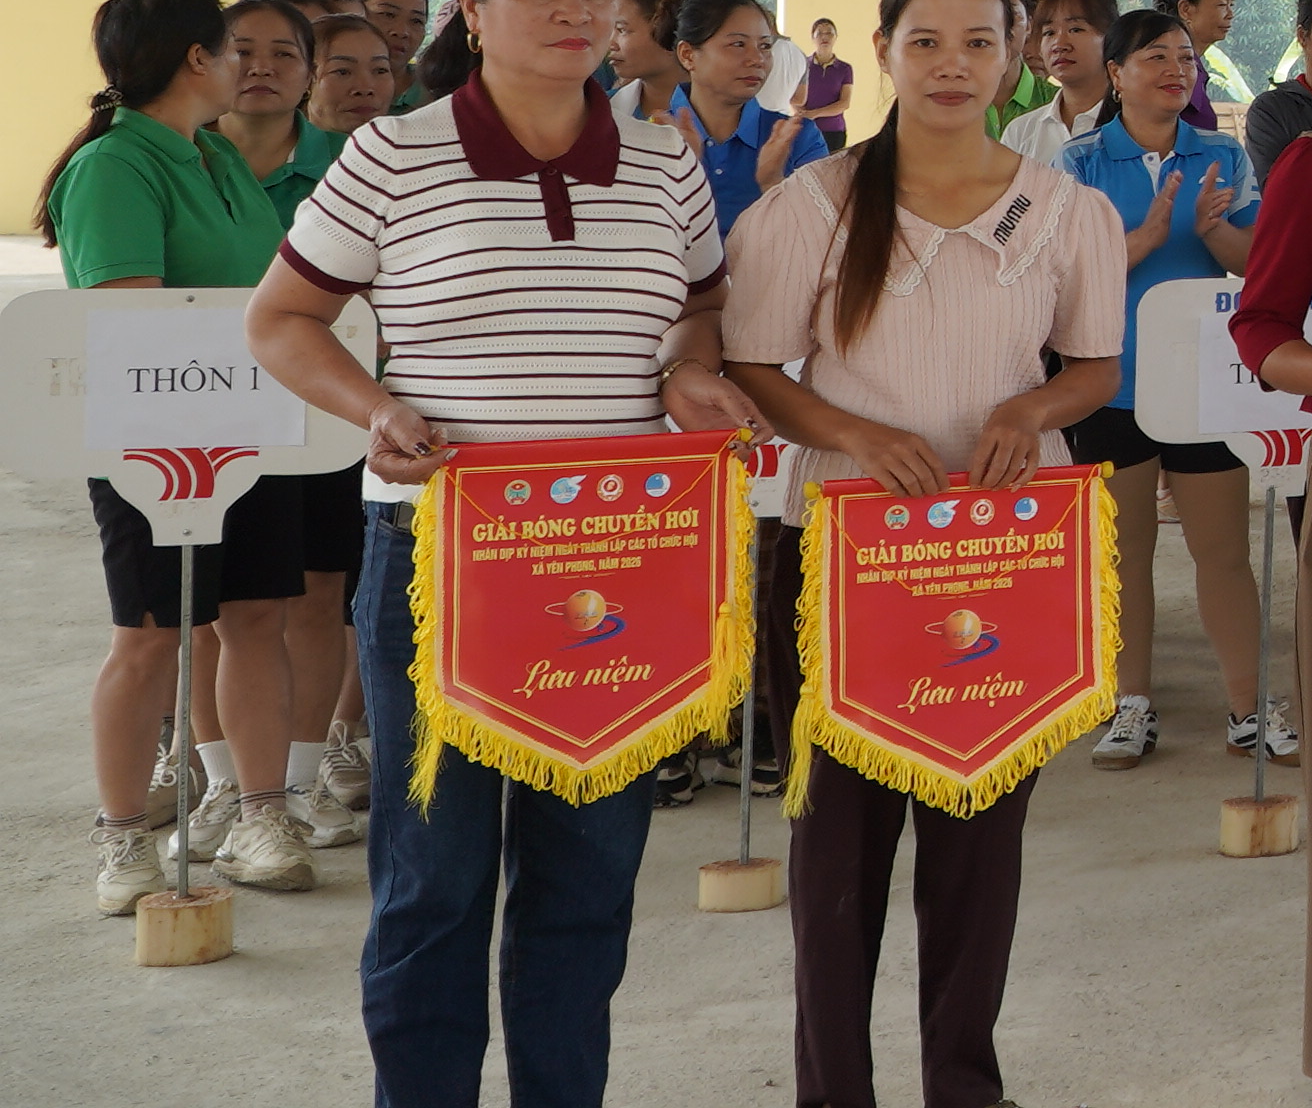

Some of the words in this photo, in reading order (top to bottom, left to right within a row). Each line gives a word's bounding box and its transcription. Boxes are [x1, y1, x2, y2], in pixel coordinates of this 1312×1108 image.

[127, 360, 236, 393] THÔN
[251, 366, 260, 391] 1
[472, 515, 517, 543] GIẢI
[521, 514, 577, 539] BÓNG
[581, 505, 660, 535] CHUYỀN
[664, 507, 699, 530] HƠI
[472, 547, 498, 562] NHÂN
[499, 547, 515, 562] DỊP
[516, 543, 529, 559] KỶ
[530, 543, 554, 560] NIỆM
[555, 541, 578, 556] NGÀY
[579, 540, 609, 555] THÀNH
[610, 538, 627, 554] LẬP
[628, 537, 646, 551] CÁC
[647, 534, 658, 549] TỔ
[660, 534, 682, 549] CHỨC
[683, 532, 698, 548] HỘI
[856, 539, 897, 566] GIẢI
[901, 538, 952, 562] BÓNG
[956, 528, 1029, 558] CHUYỀN
[1033, 529, 1065, 551] HƠI
[512, 660, 579, 700] Lưu
[582, 656, 656, 692] niệm
[897, 676, 958, 715] Lưu
[961, 672, 1028, 707] niệm
